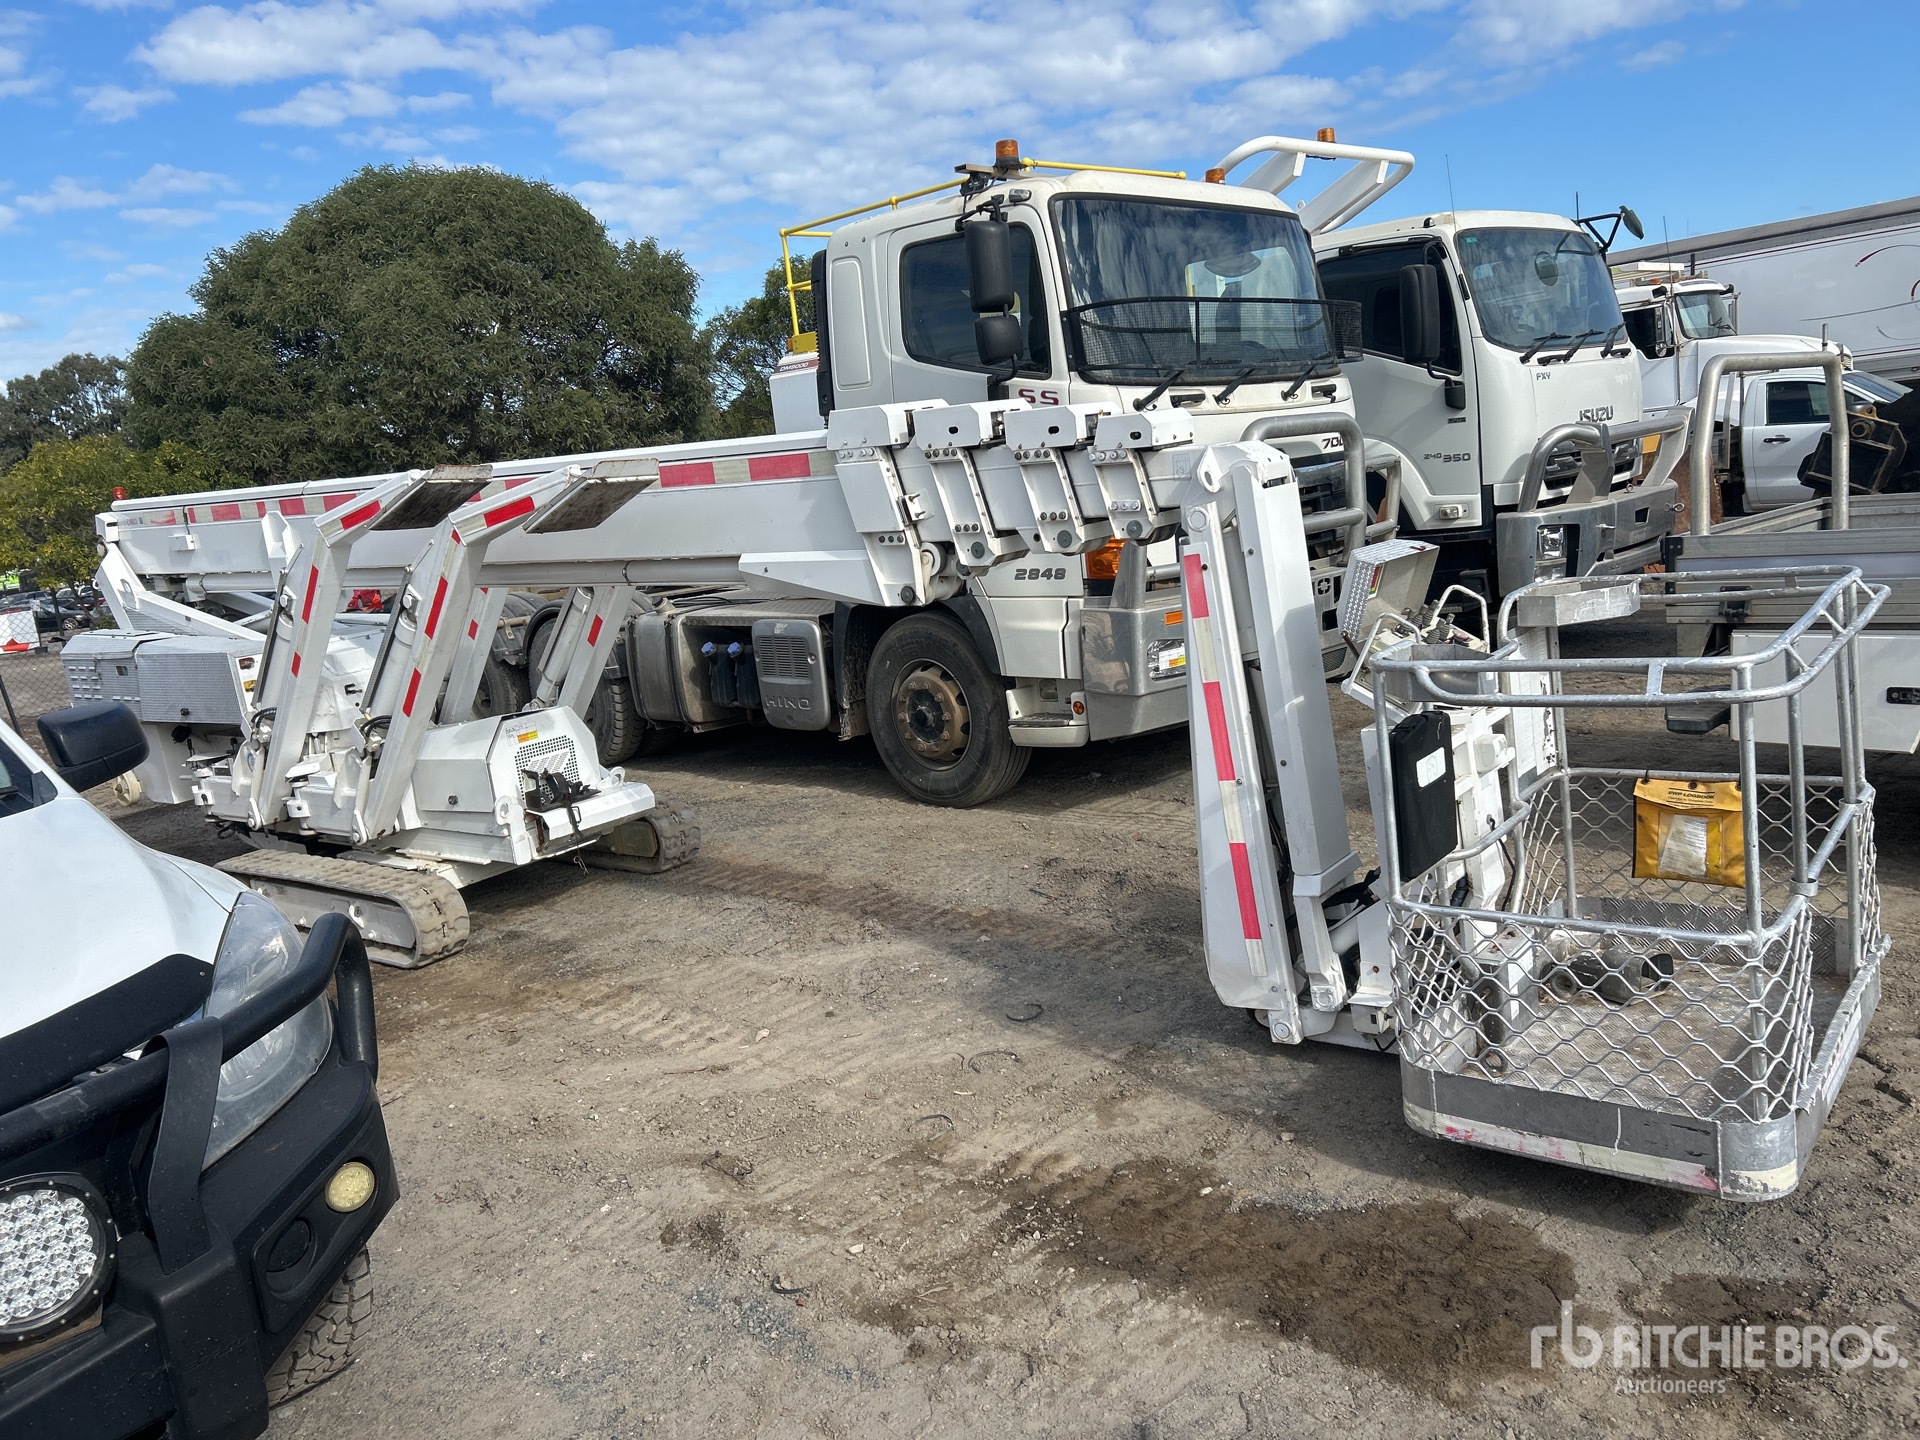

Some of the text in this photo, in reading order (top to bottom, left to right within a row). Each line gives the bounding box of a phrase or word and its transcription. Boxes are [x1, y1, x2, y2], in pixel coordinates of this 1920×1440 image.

[1536, 372, 1551, 381] FXY
[1579, 405, 1614, 422] ISUZU
[1442, 453, 1472, 462] 350
[1014, 568, 1066, 580] 2848
[765, 695, 811, 710] HINO
